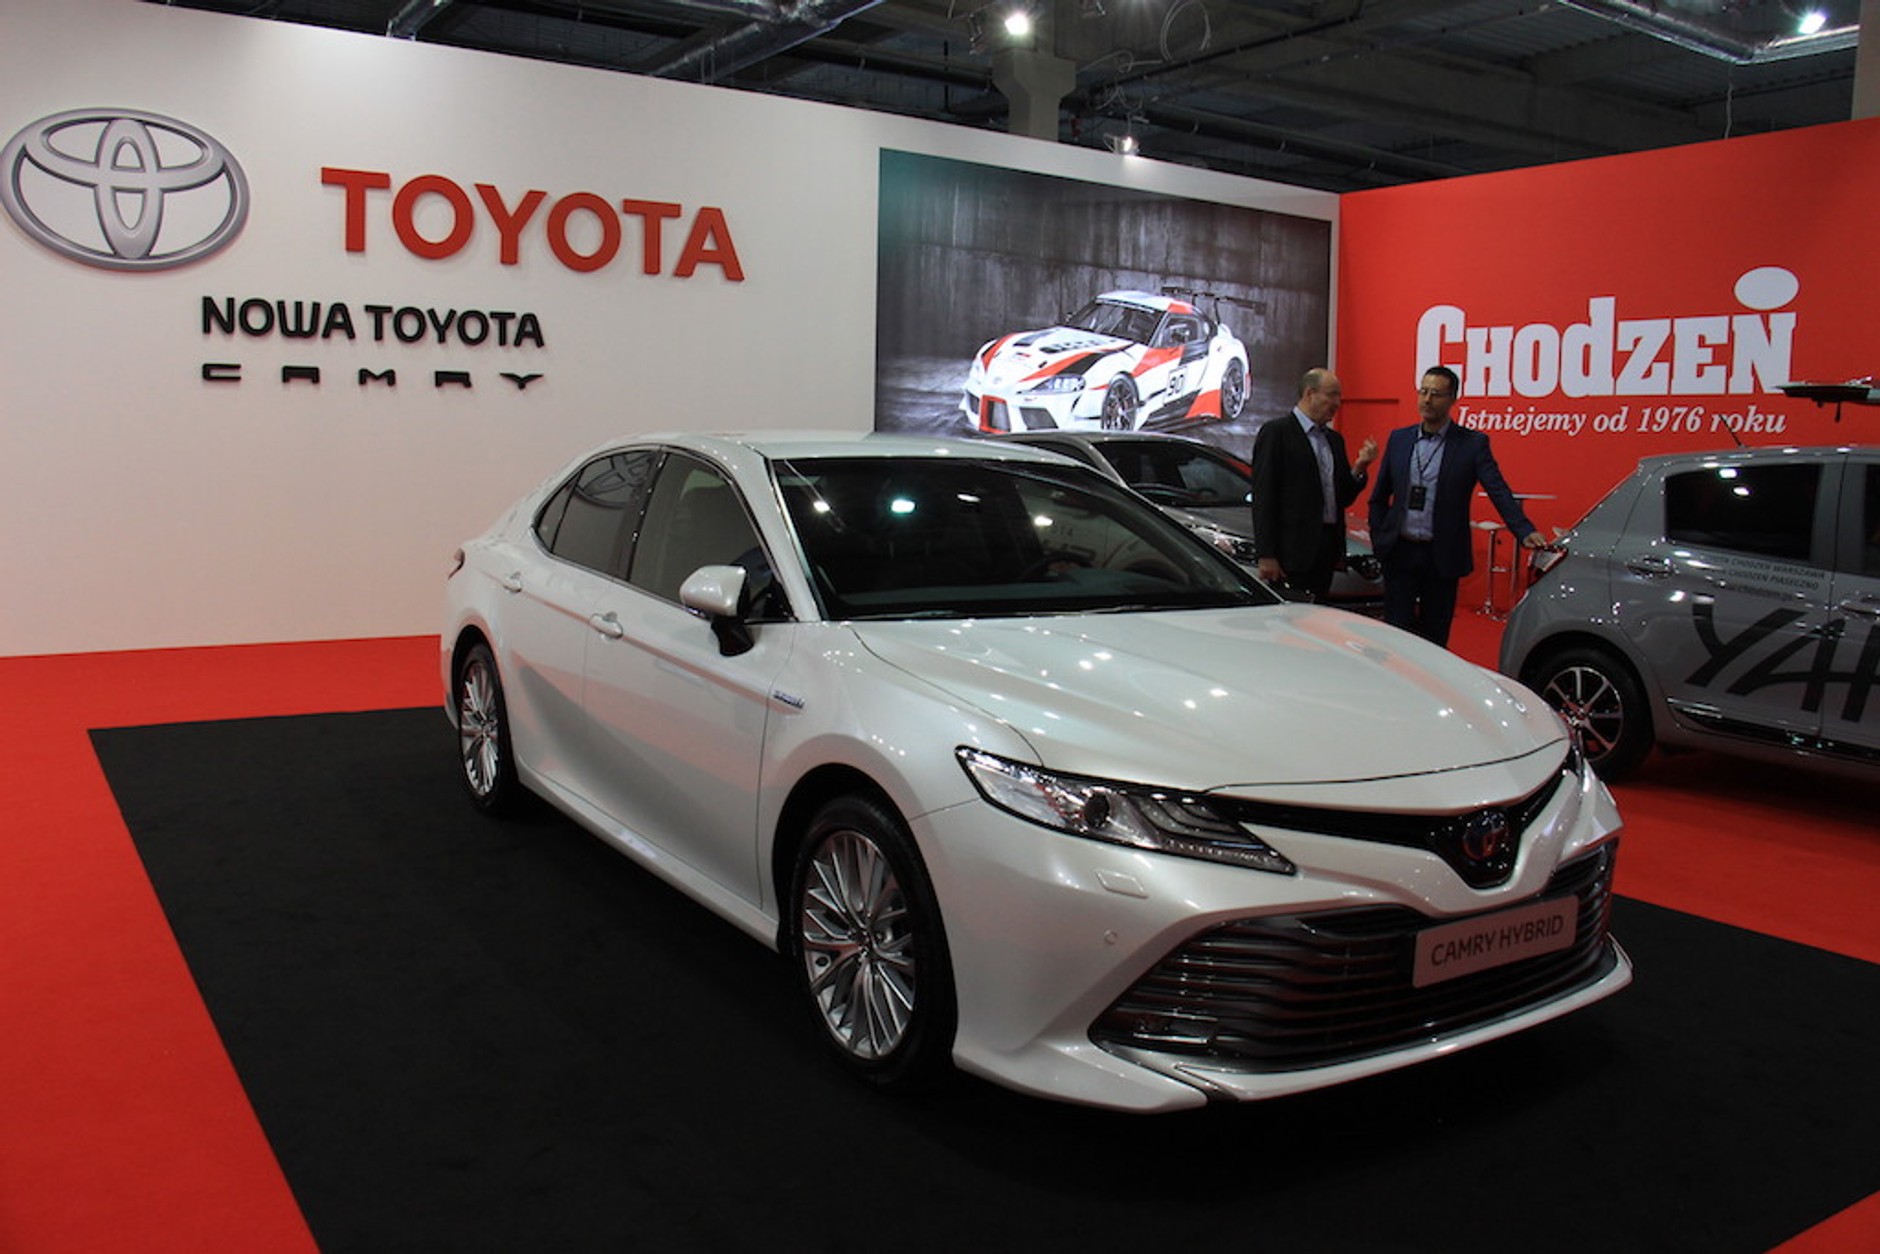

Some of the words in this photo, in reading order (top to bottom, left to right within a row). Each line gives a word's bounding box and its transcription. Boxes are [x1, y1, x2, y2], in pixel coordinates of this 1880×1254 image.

[321, 167, 744, 282] TOYOTA
[202, 296, 355, 340] NOWA
[365, 304, 545, 348] TOYOTA
[202, 364, 544, 389] CAMRY
[1457, 406, 1586, 436] Istniejemy
[1593, 406, 1629, 433] od
[1637, 406, 1705, 433] 1976
[1710, 405, 1786, 434] roku
[1430, 930, 1497, 967] CAMRY
[1499, 915, 1564, 947] HYBRID
